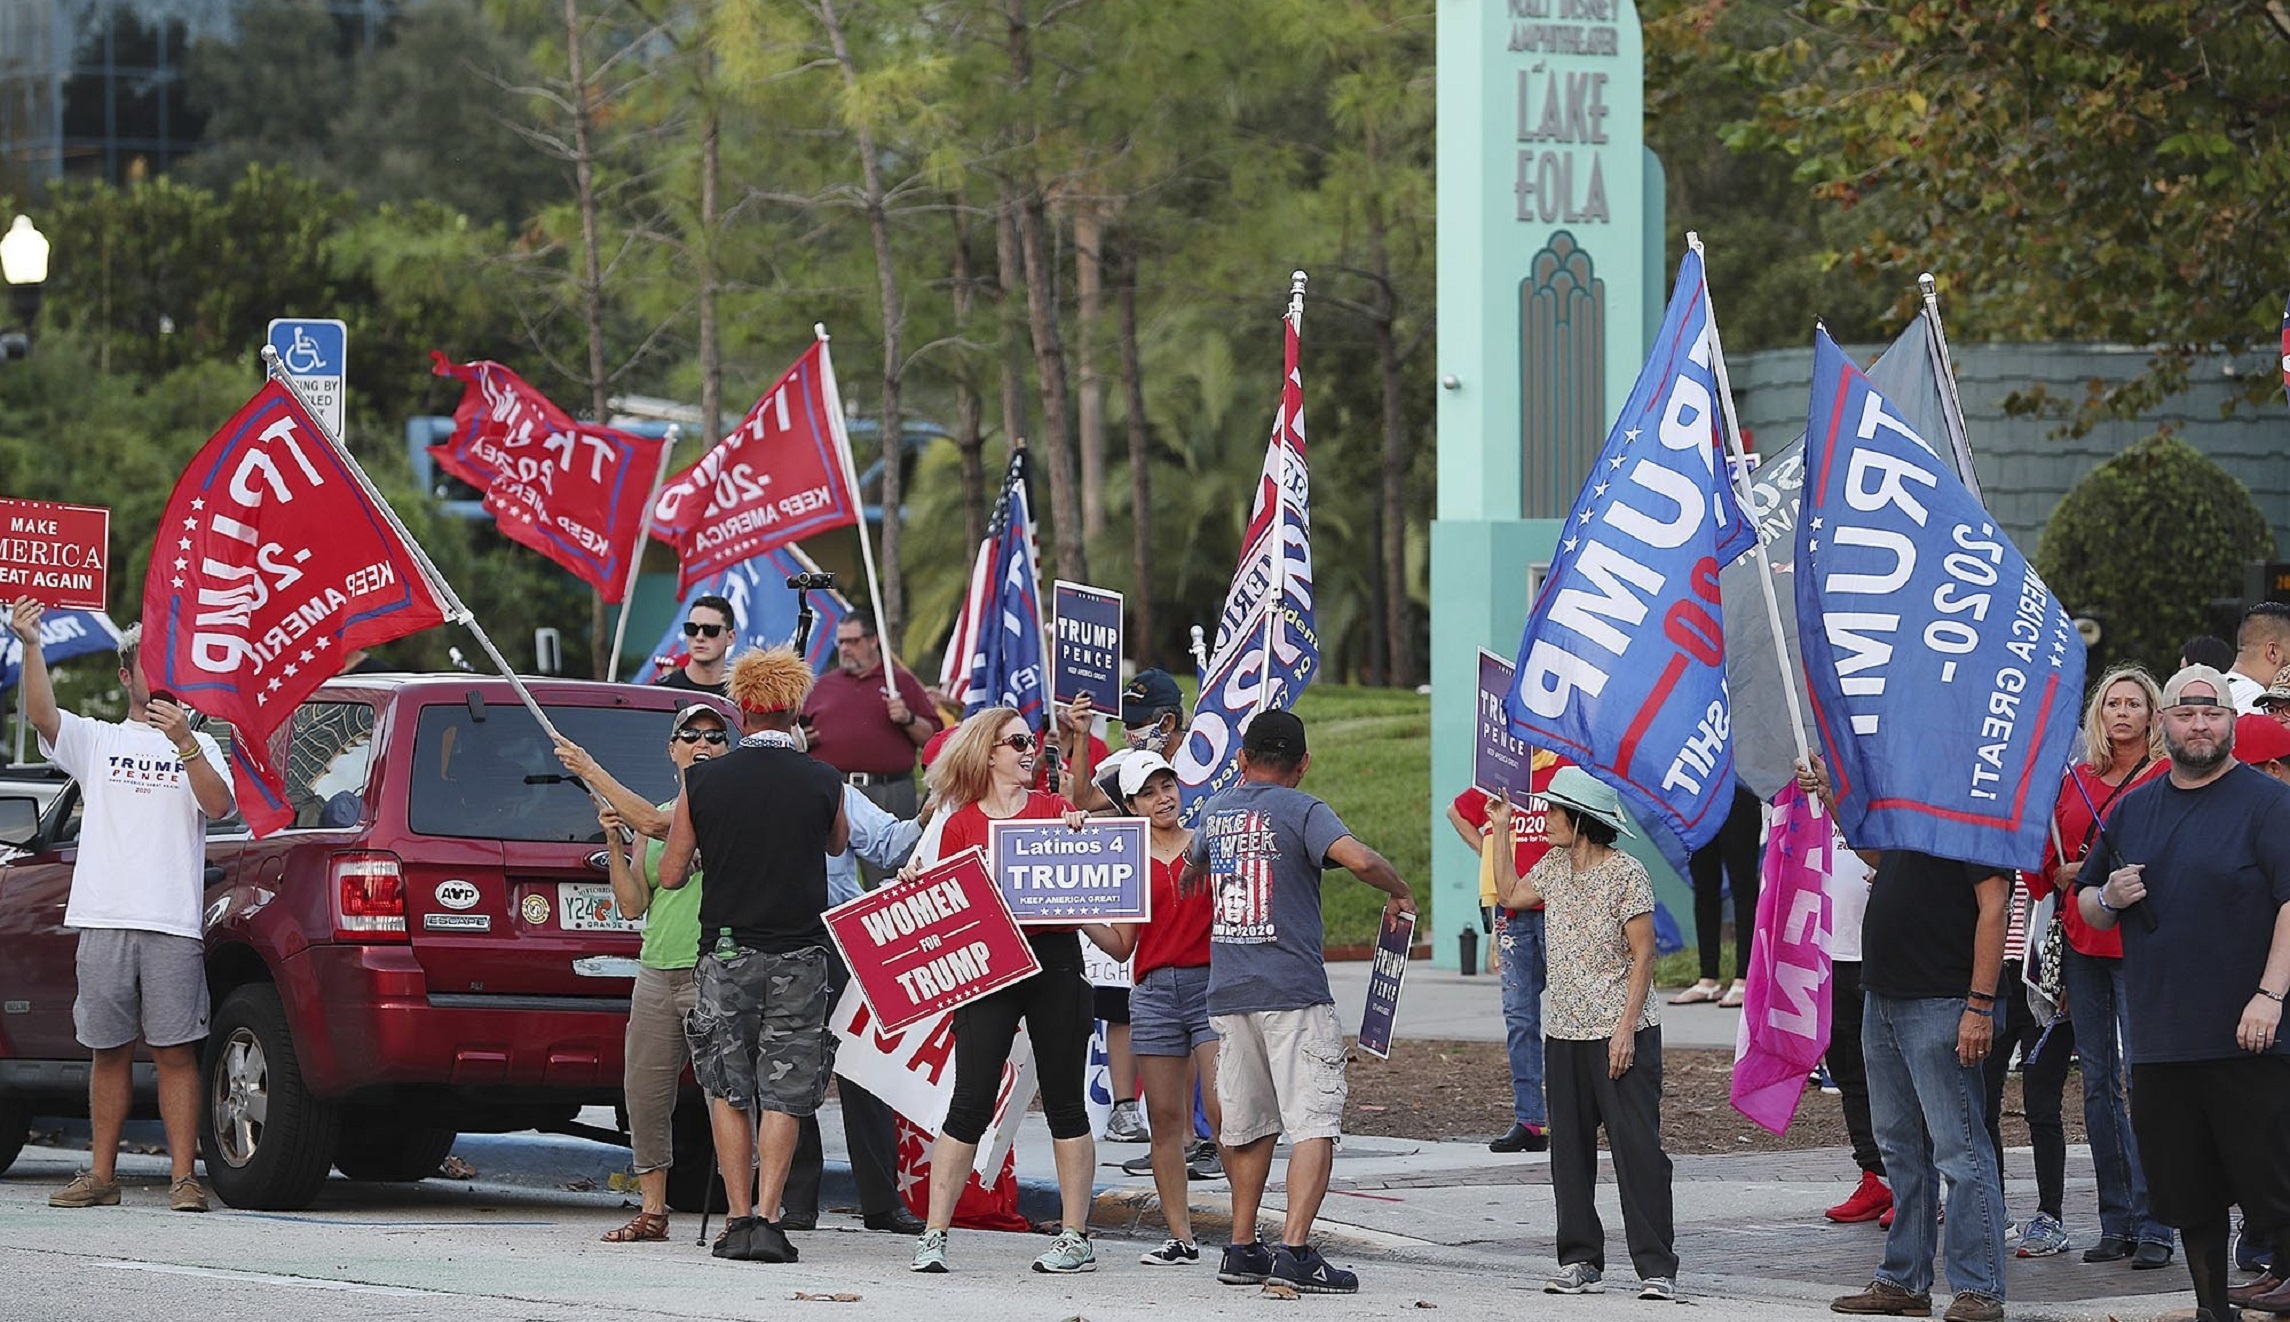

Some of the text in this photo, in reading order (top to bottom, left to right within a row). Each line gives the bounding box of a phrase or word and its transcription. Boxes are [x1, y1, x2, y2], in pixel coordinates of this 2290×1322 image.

[1516, 69, 1609, 144] LAKE
[1514, 150, 1610, 224] EOLA
[324, 381, 338, 391] BY
[11, 517, 58, 535] MAKE
[0, 538, 103, 569] MERICA
[0, 567, 93, 590] EAT AGAIN
[1057, 617, 1117, 650] TRUMP
[1063, 645, 1112, 669] PENCE
[1480, 689, 1507, 726] TRU
[1483, 723, 1525, 756] PENCE
[109, 756, 185, 773] TRUMP
[112, 769, 178, 783] PENCE
[1205, 813, 1248, 839] BIKE
[1516, 815, 1546, 834] 020
[1016, 836, 1124, 856] Latinos 4
[1220, 831, 1278, 858] WEEK
[1007, 863, 1134, 890] TRUMP
[565, 897, 594, 920] Y24
[861, 876, 970, 947] WOMEN
[1020, 895, 1120, 905] KEEP AMERICA GREAT!
[428, 916, 486, 925] ESCAPE
[1242, 923, 1275, 937] 2020
[919, 934, 942, 953] FOR
[895, 940, 990, 1006] TRUMP
[1085, 961, 1129, 980] IGH
[1375, 948, 1404, 979] TRUMP
